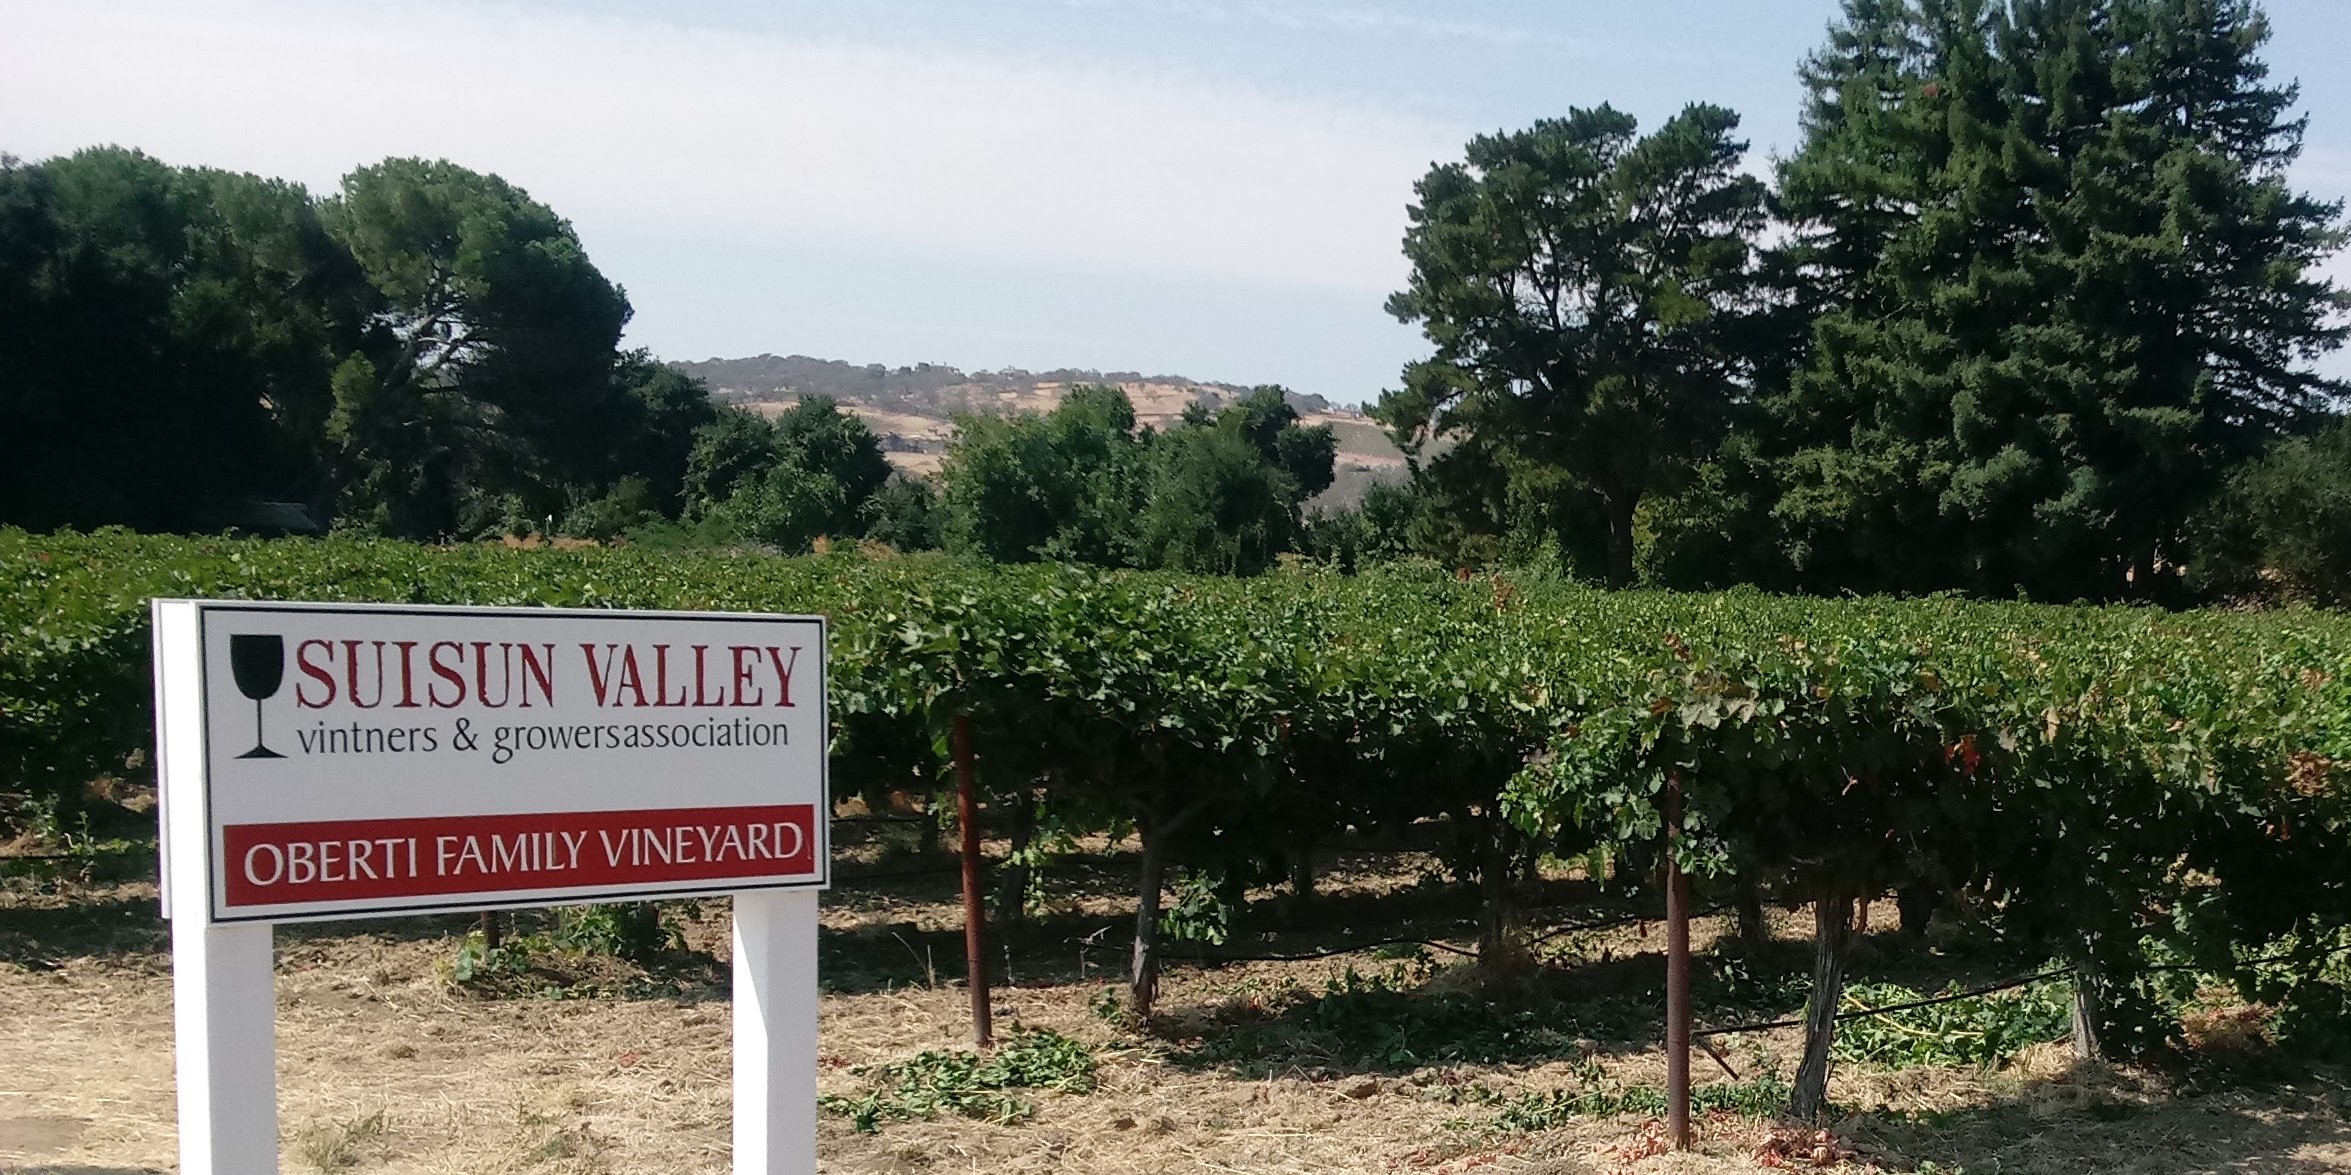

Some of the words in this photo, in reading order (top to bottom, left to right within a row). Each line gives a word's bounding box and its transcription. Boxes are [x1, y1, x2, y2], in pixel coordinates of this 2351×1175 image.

[295, 639, 556, 709] SUISUN
[579, 643, 802, 708] VALLEY
[296, 720, 437, 754] vintners
[452, 717, 479, 752] &
[244, 837, 417, 886] OBERTI
[435, 831, 589, 876] FAMILY
[598, 822, 802, 868] VINEYARD
